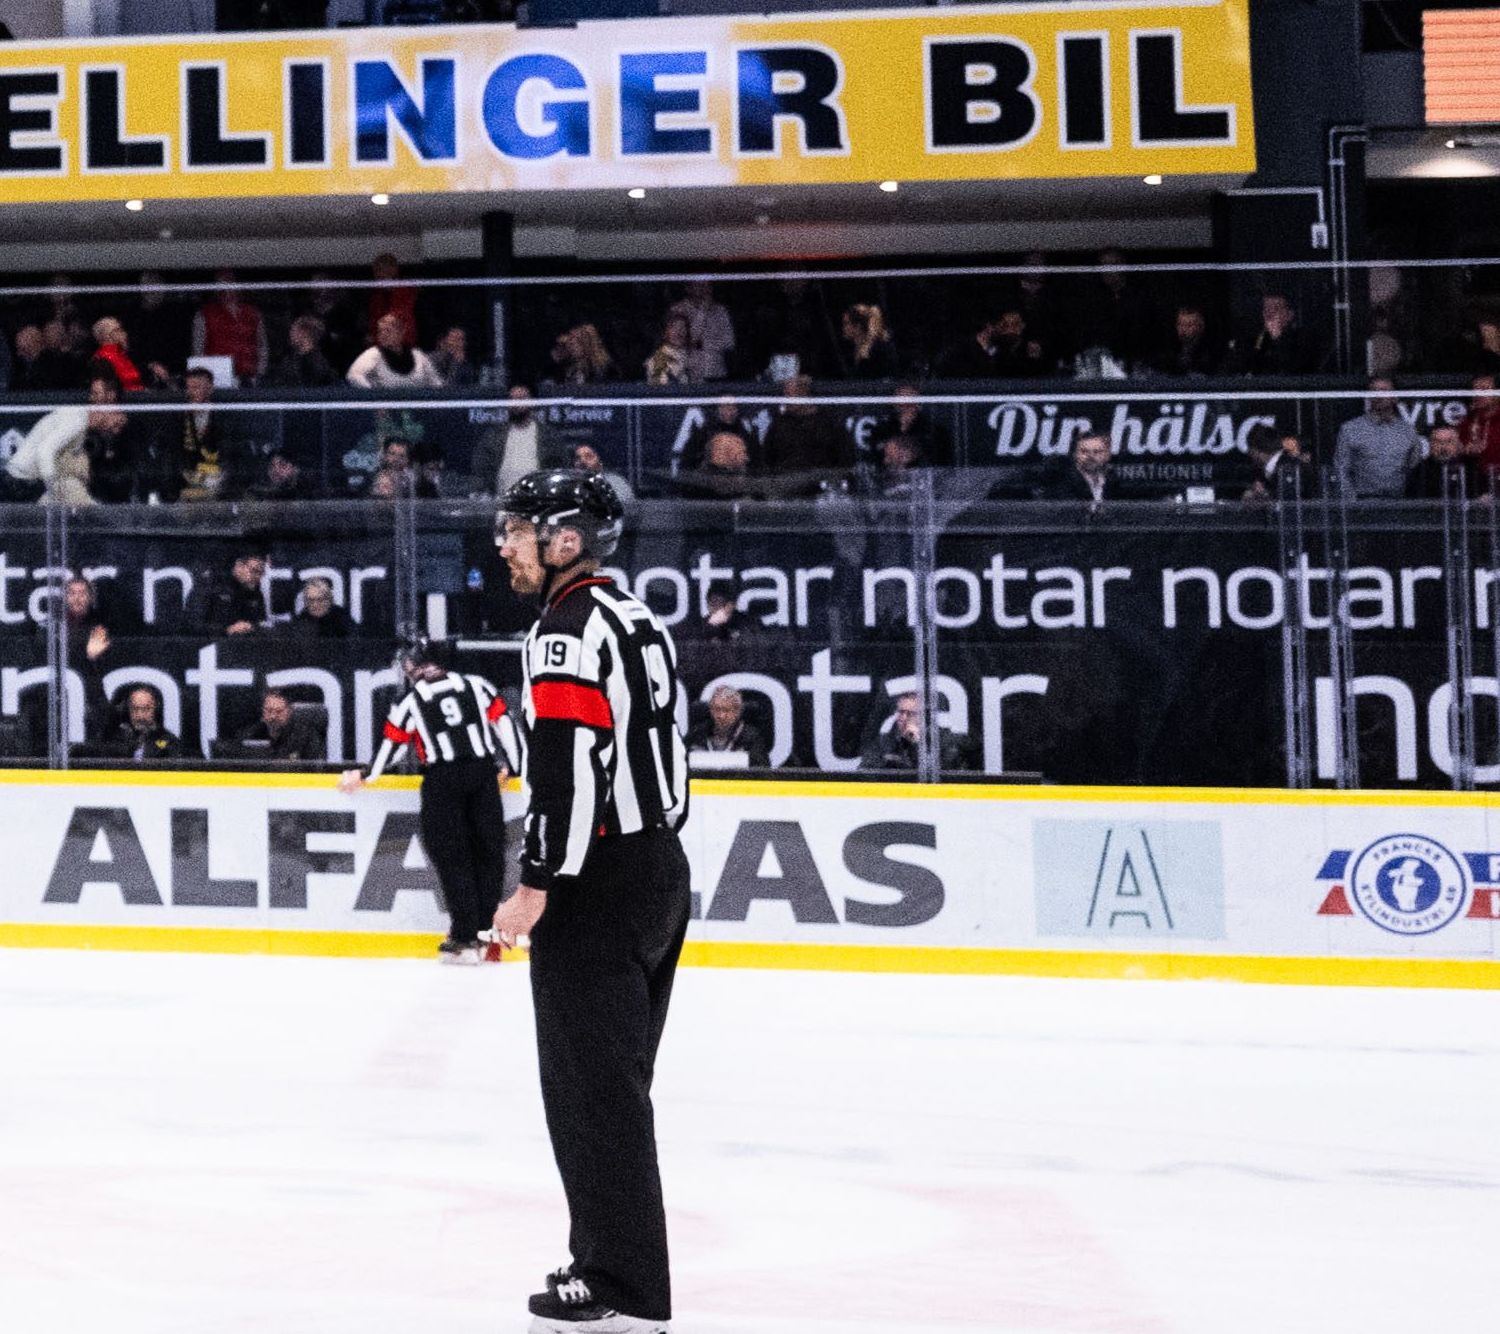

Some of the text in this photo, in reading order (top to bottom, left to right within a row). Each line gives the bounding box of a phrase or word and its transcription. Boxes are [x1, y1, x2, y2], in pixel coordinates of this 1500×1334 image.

[923, 27, 1238, 154] BIL
[865, 553, 1130, 630] notar
[1162, 553, 1441, 630] notar
[543, 639, 568, 668] 19
